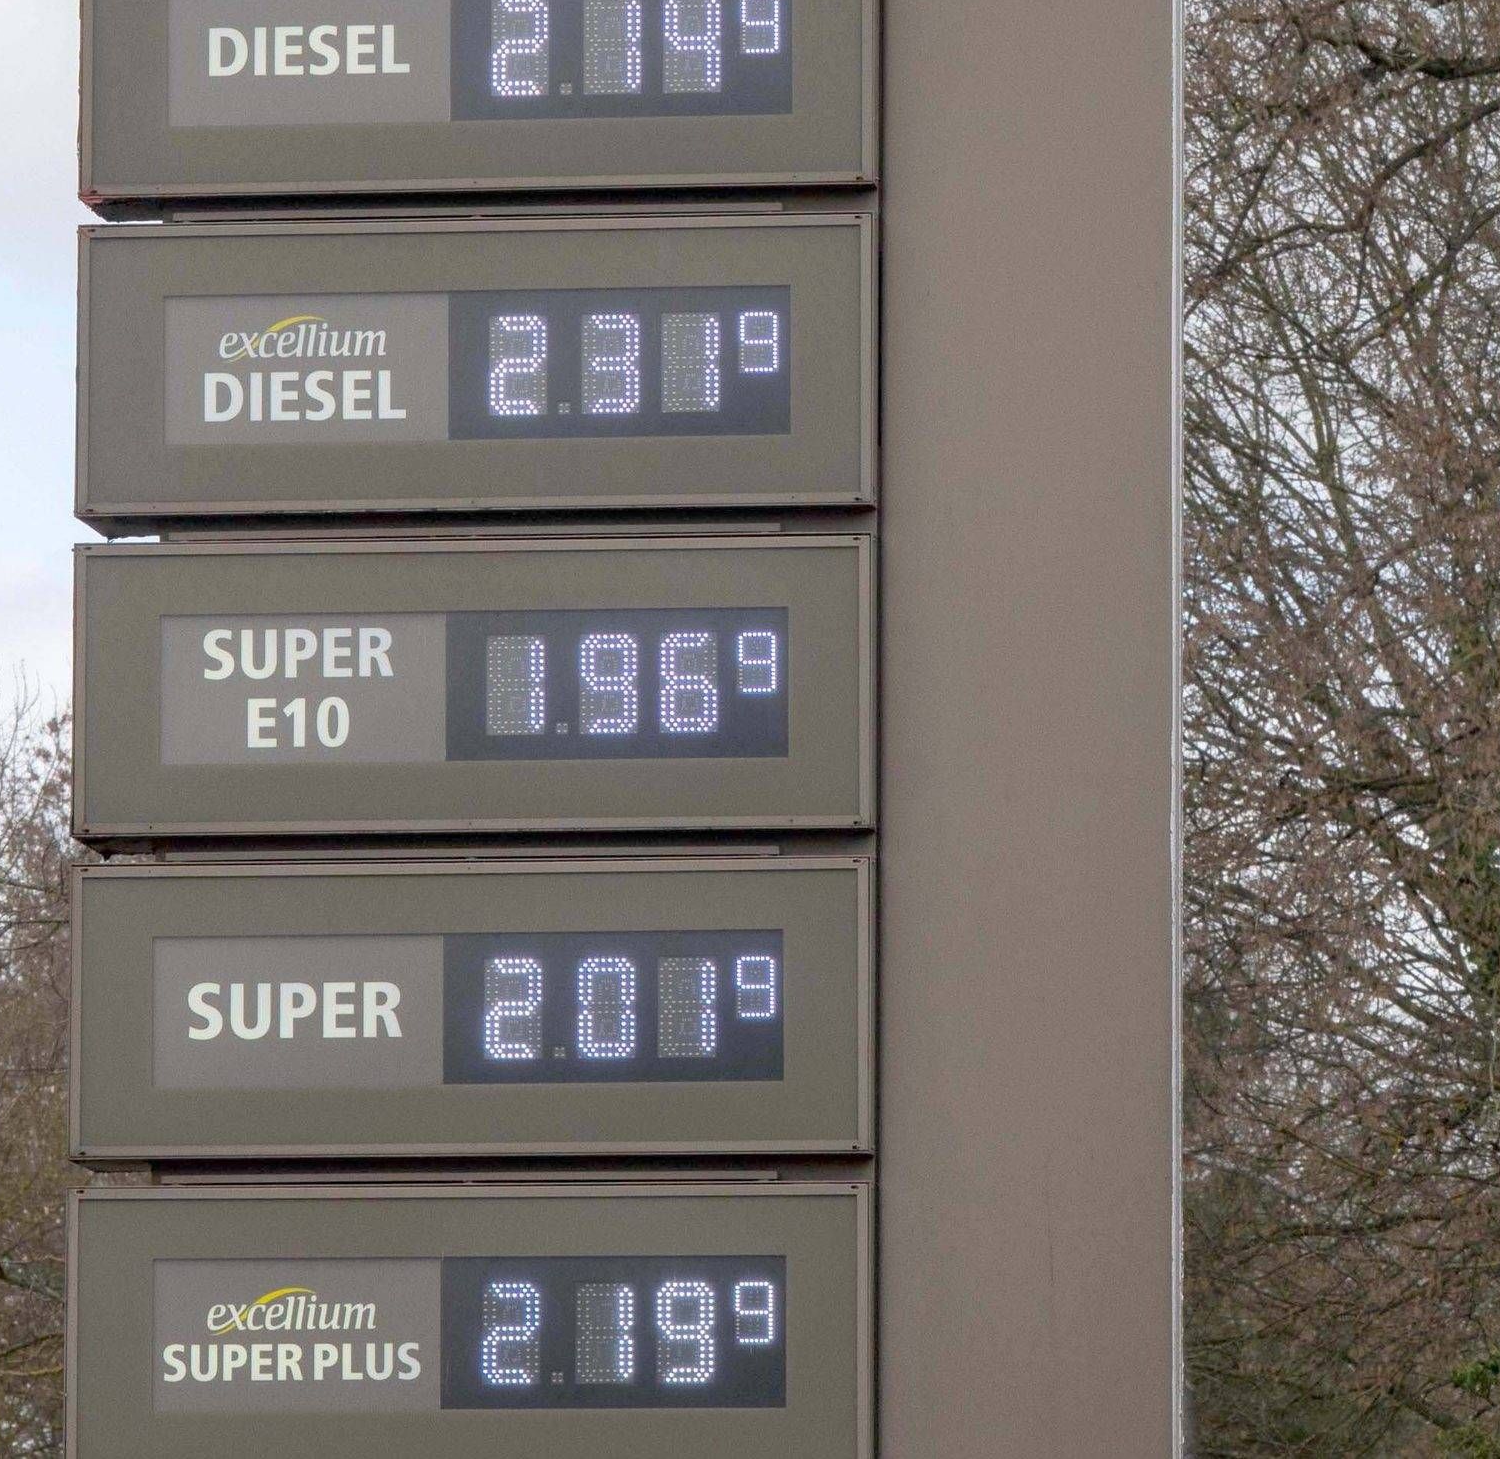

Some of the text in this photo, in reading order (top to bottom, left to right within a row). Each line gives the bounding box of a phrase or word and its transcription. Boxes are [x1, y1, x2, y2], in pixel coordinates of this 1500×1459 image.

[208, 25, 411, 78] DIESEL
[219, 320, 388, 363] excellium
[204, 369, 407, 422] DIESEL
[202, 627, 395, 681] SUPER
[246, 697, 351, 748] E10
[186, 982, 404, 1040] SUPER
[206, 1291, 377, 1334] excellium
[161, 1342, 422, 1383] SUPER PLUS
